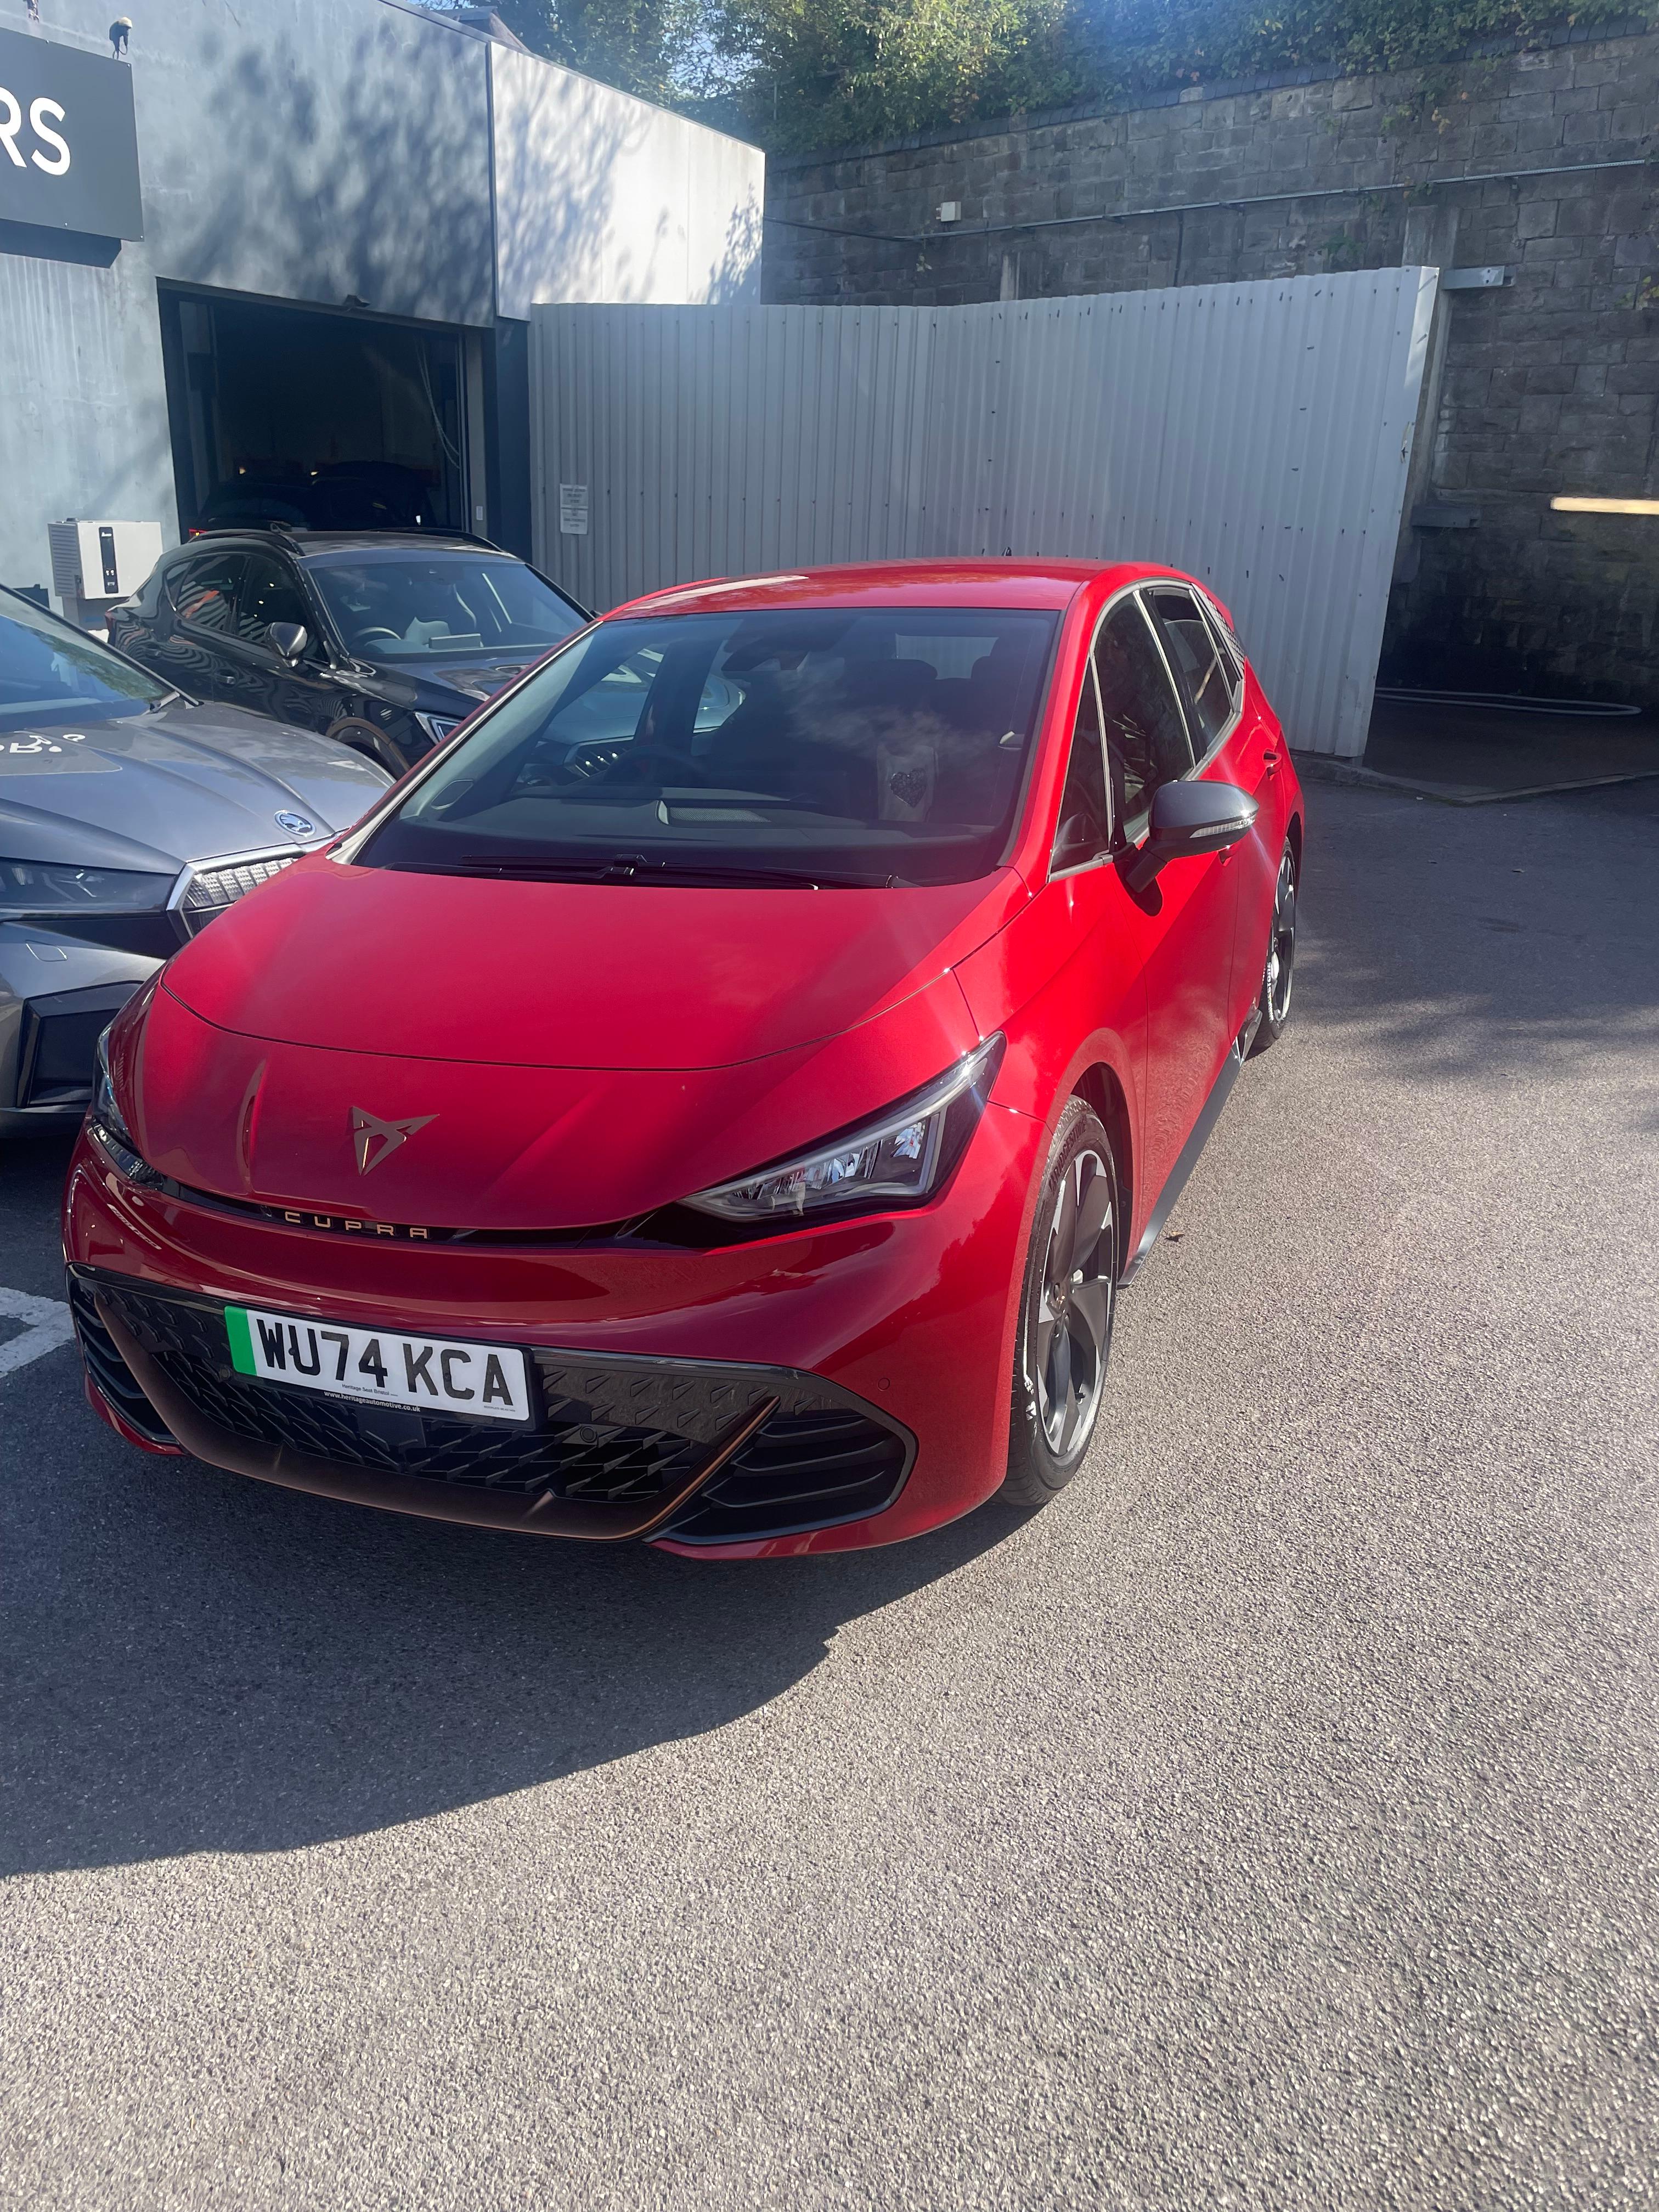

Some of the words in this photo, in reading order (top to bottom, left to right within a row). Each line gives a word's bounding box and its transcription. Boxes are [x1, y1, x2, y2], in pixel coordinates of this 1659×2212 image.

[284, 1211, 428, 1239] CUPRA
[256, 1318, 388, 1388] WU74
[402, 1342, 514, 1406] KCA
[342, 1383, 362, 1392] Heritage
[323, 1391, 421, 1412] www.heritageautomotive.co.uk
